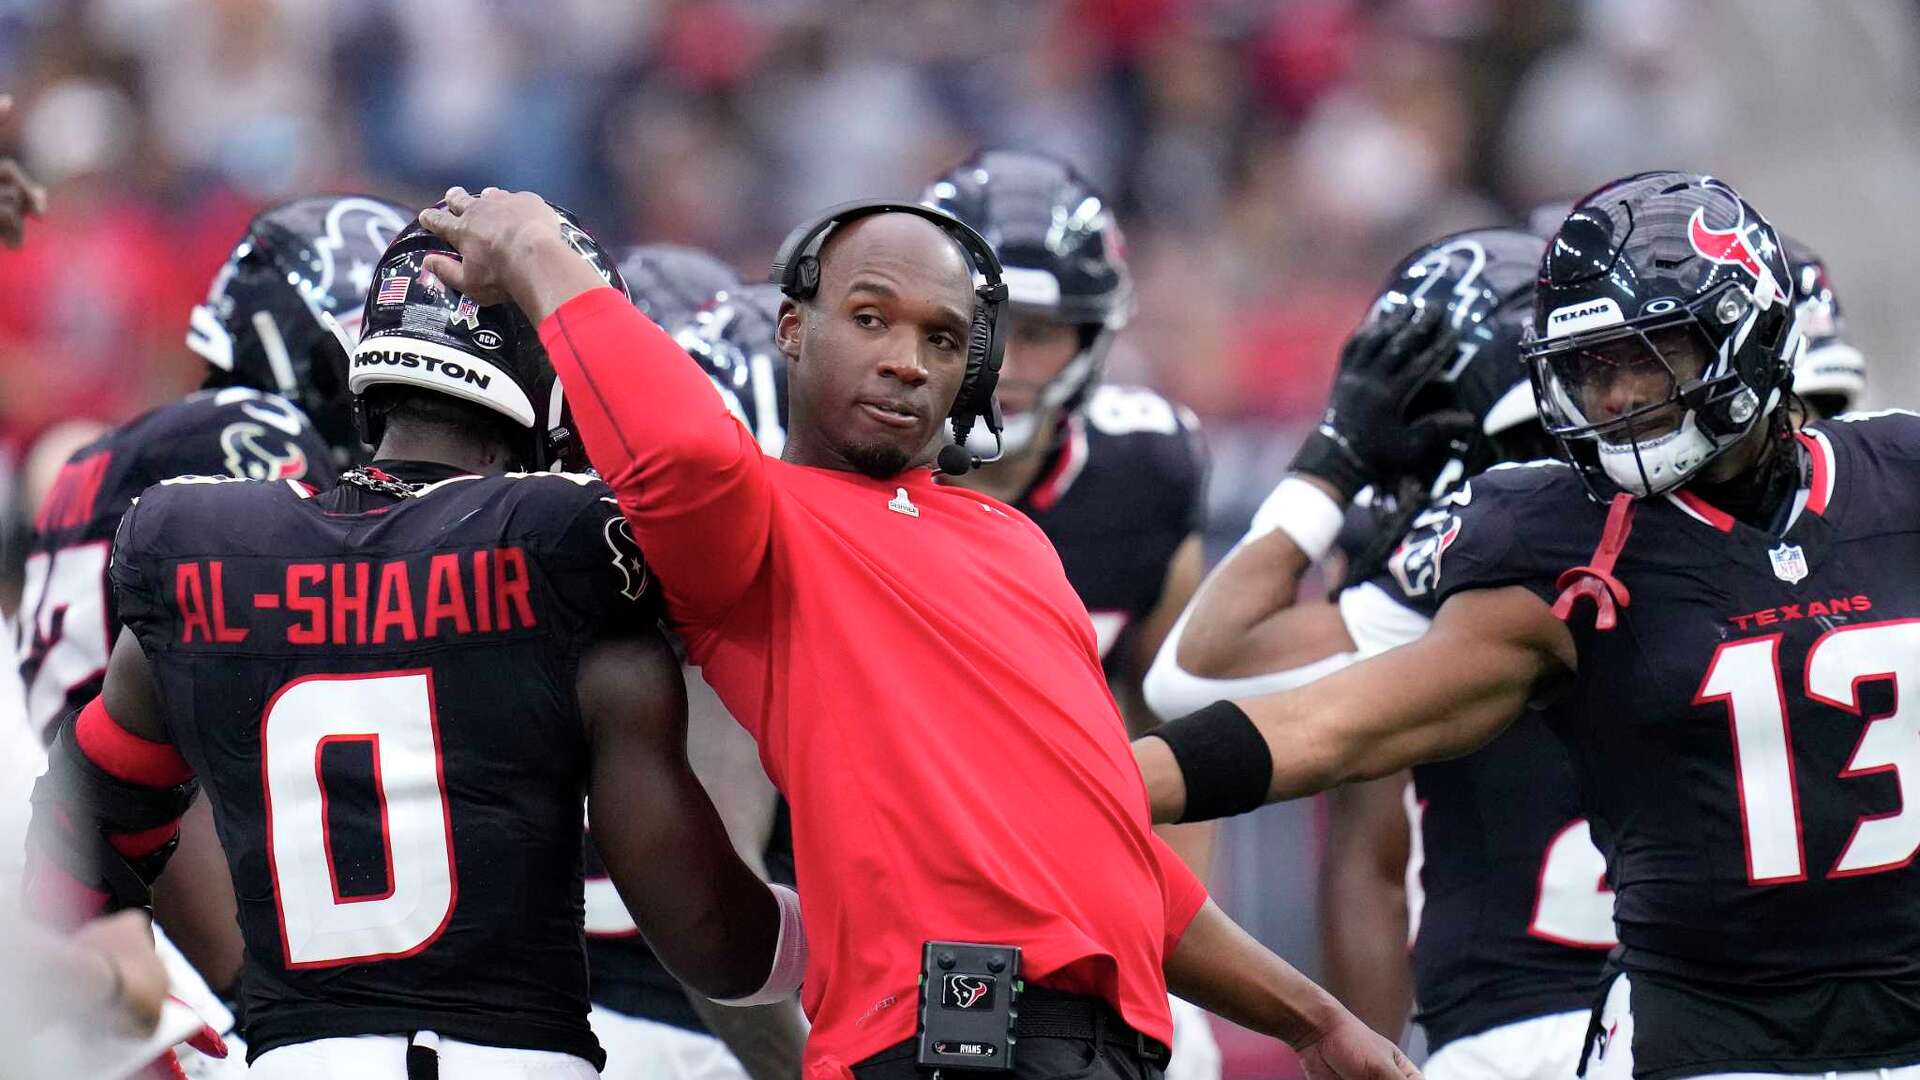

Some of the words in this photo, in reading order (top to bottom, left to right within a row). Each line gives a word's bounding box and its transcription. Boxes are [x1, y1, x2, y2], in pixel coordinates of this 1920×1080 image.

[1553, 305, 1609, 323] TEXANS
[354, 351, 492, 390] HOUSTON
[174, 546, 538, 645] AL-SHAAIR
[1728, 595, 1872, 631] TEXANS
[1691, 617, 1920, 886] 13
[259, 667, 459, 970] 0
